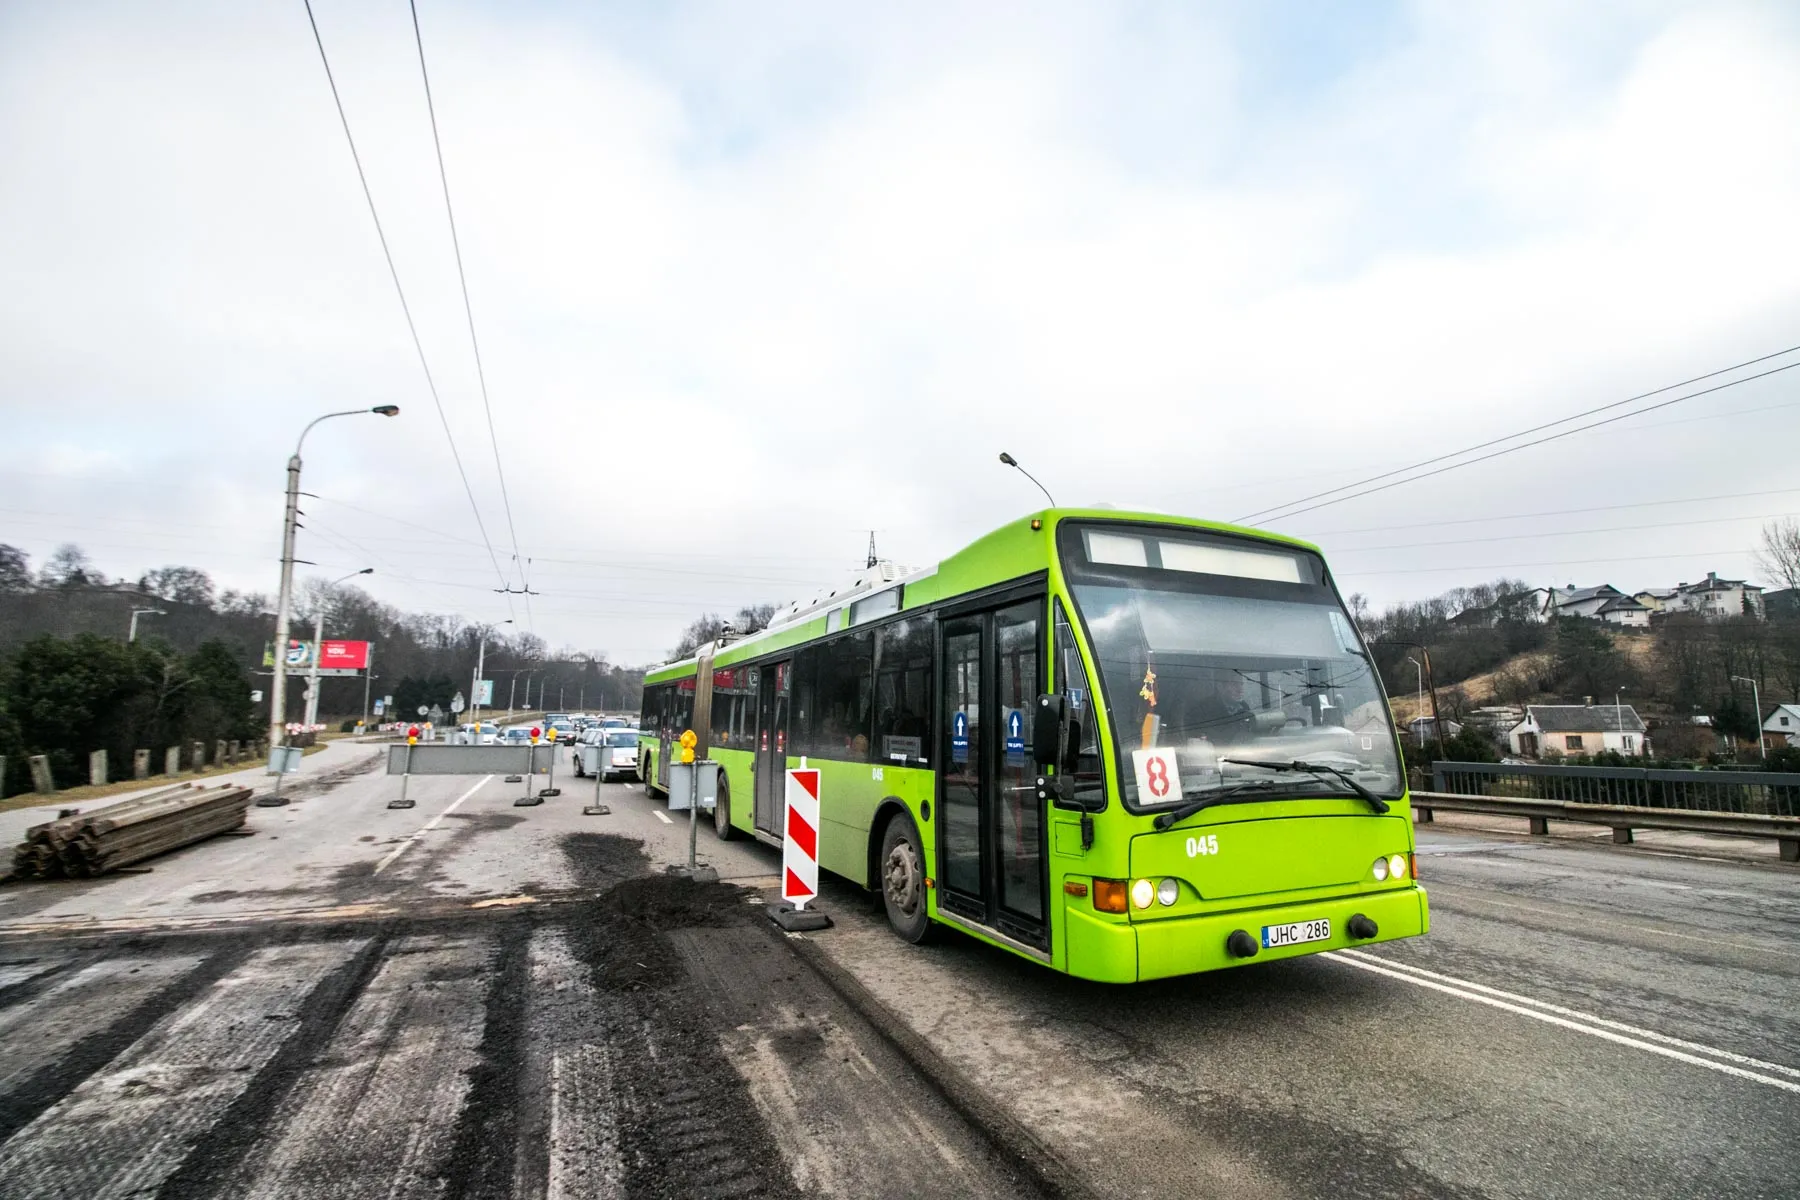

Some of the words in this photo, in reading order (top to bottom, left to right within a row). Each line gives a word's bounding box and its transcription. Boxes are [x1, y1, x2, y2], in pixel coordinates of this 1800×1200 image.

[1146, 756, 1170, 797] 8
[1186, 834, 1219, 858] 045
[1270, 925, 1298, 944] JHC
[1306, 921, 1329, 939] 286
